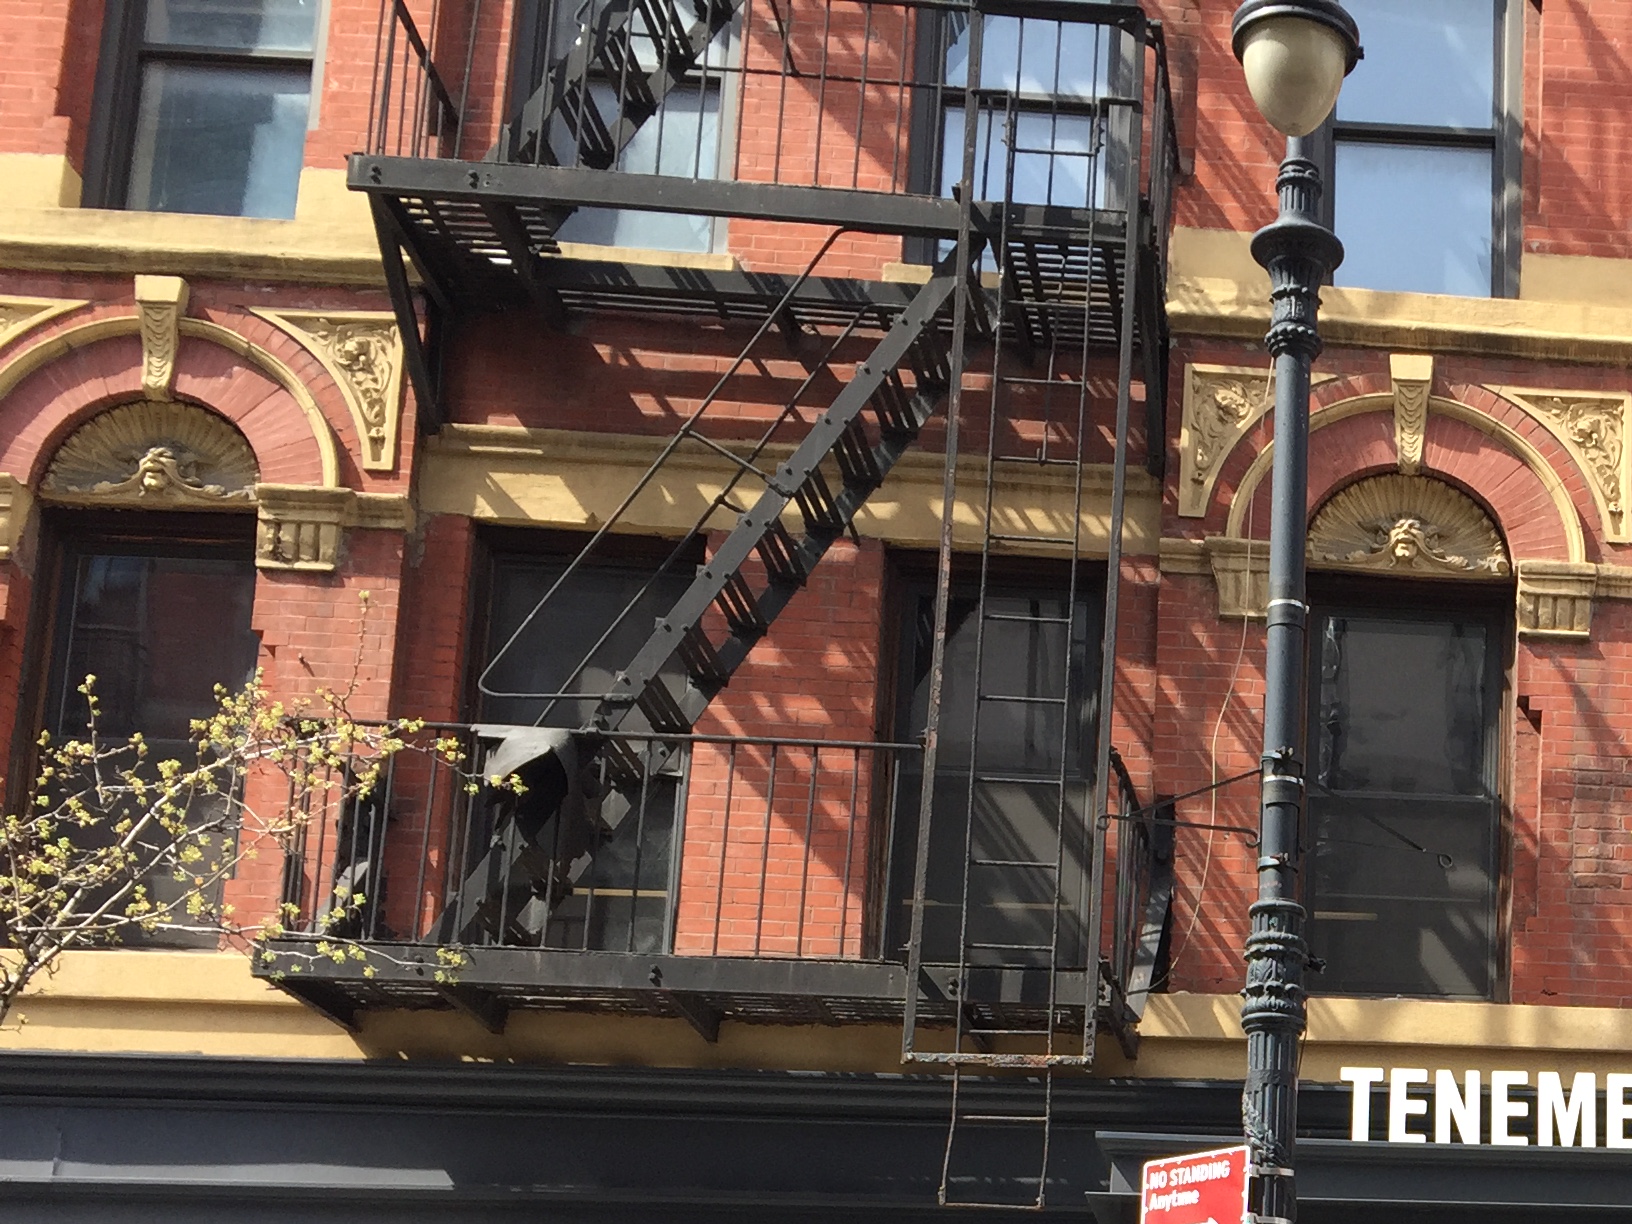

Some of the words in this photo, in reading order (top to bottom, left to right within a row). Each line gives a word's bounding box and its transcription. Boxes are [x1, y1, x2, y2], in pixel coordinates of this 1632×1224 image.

[1149, 1171, 1168, 1190] NO
[1169, 1160, 1231, 1187] STANDING
[1149, 1189, 1200, 1212] Anytime
